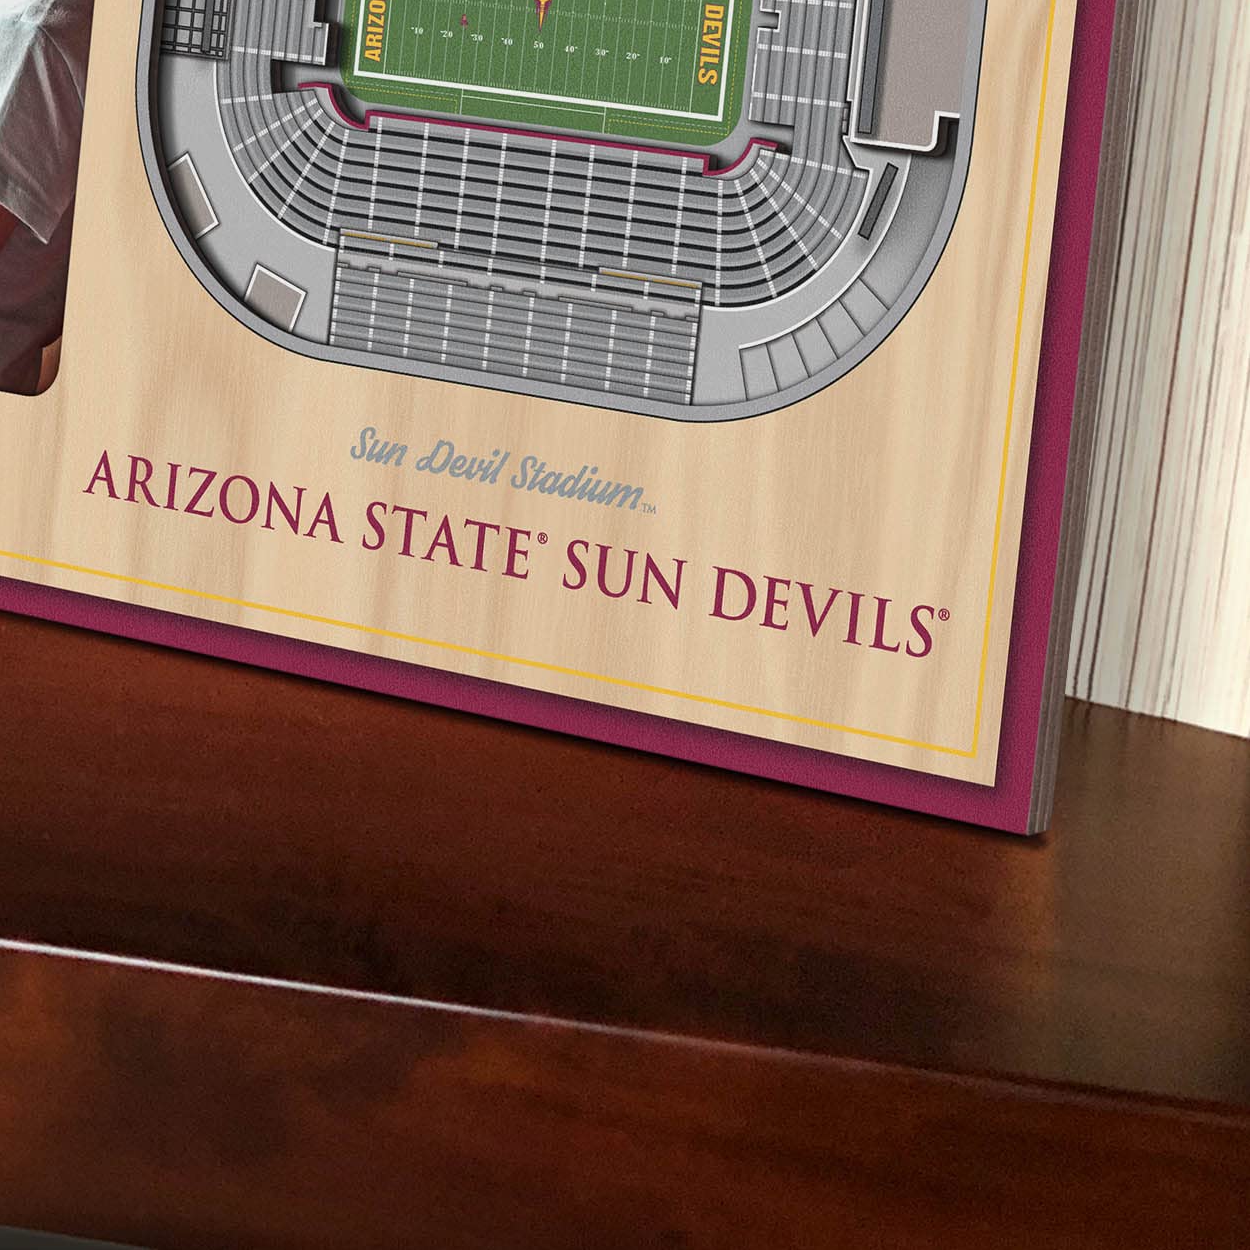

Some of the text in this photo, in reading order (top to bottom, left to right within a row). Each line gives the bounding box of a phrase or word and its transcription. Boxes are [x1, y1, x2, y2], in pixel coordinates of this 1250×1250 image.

[697, 3, 725, 85] DEVILS
[350, 426, 408, 467] Sun
[415, 439, 510, 484] Devil
[84, 450, 342, 544] ARIZONA
[562, 538, 694, 609] SUN
